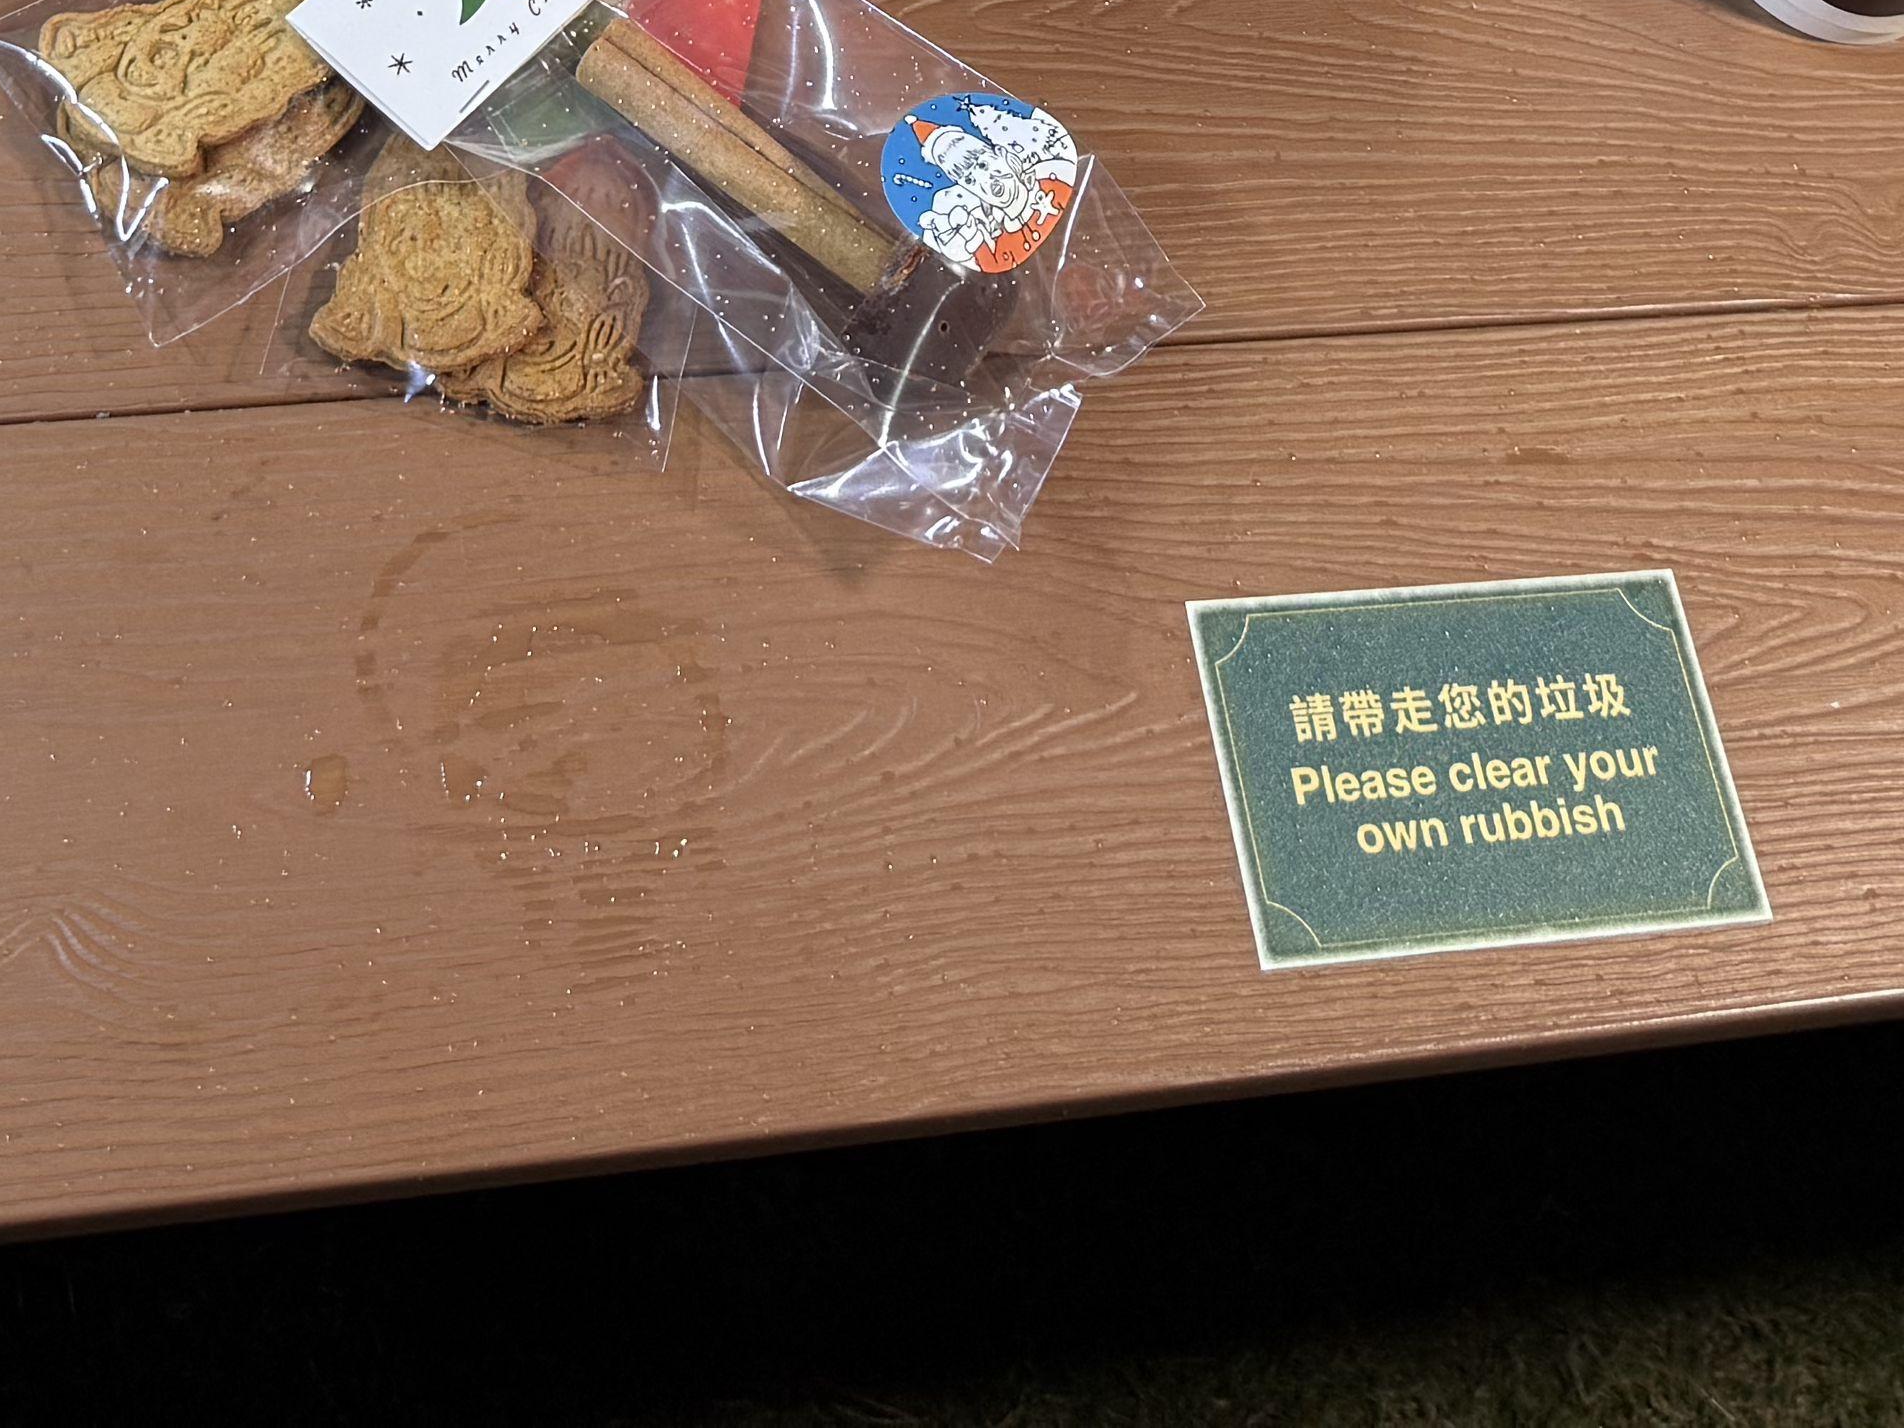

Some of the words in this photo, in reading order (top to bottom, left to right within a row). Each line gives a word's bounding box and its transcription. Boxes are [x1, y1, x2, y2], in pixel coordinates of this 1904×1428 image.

[451, 21, 521, 83] Merry
[1289, 672, 1632, 743] 請帶走您的垃圾
[1289, 759, 1438, 806] Please
[1448, 750, 1552, 792] clear
[1569, 743, 1659, 793] your
[1356, 815, 1449, 855] own
[1459, 795, 1626, 846] rubbish
